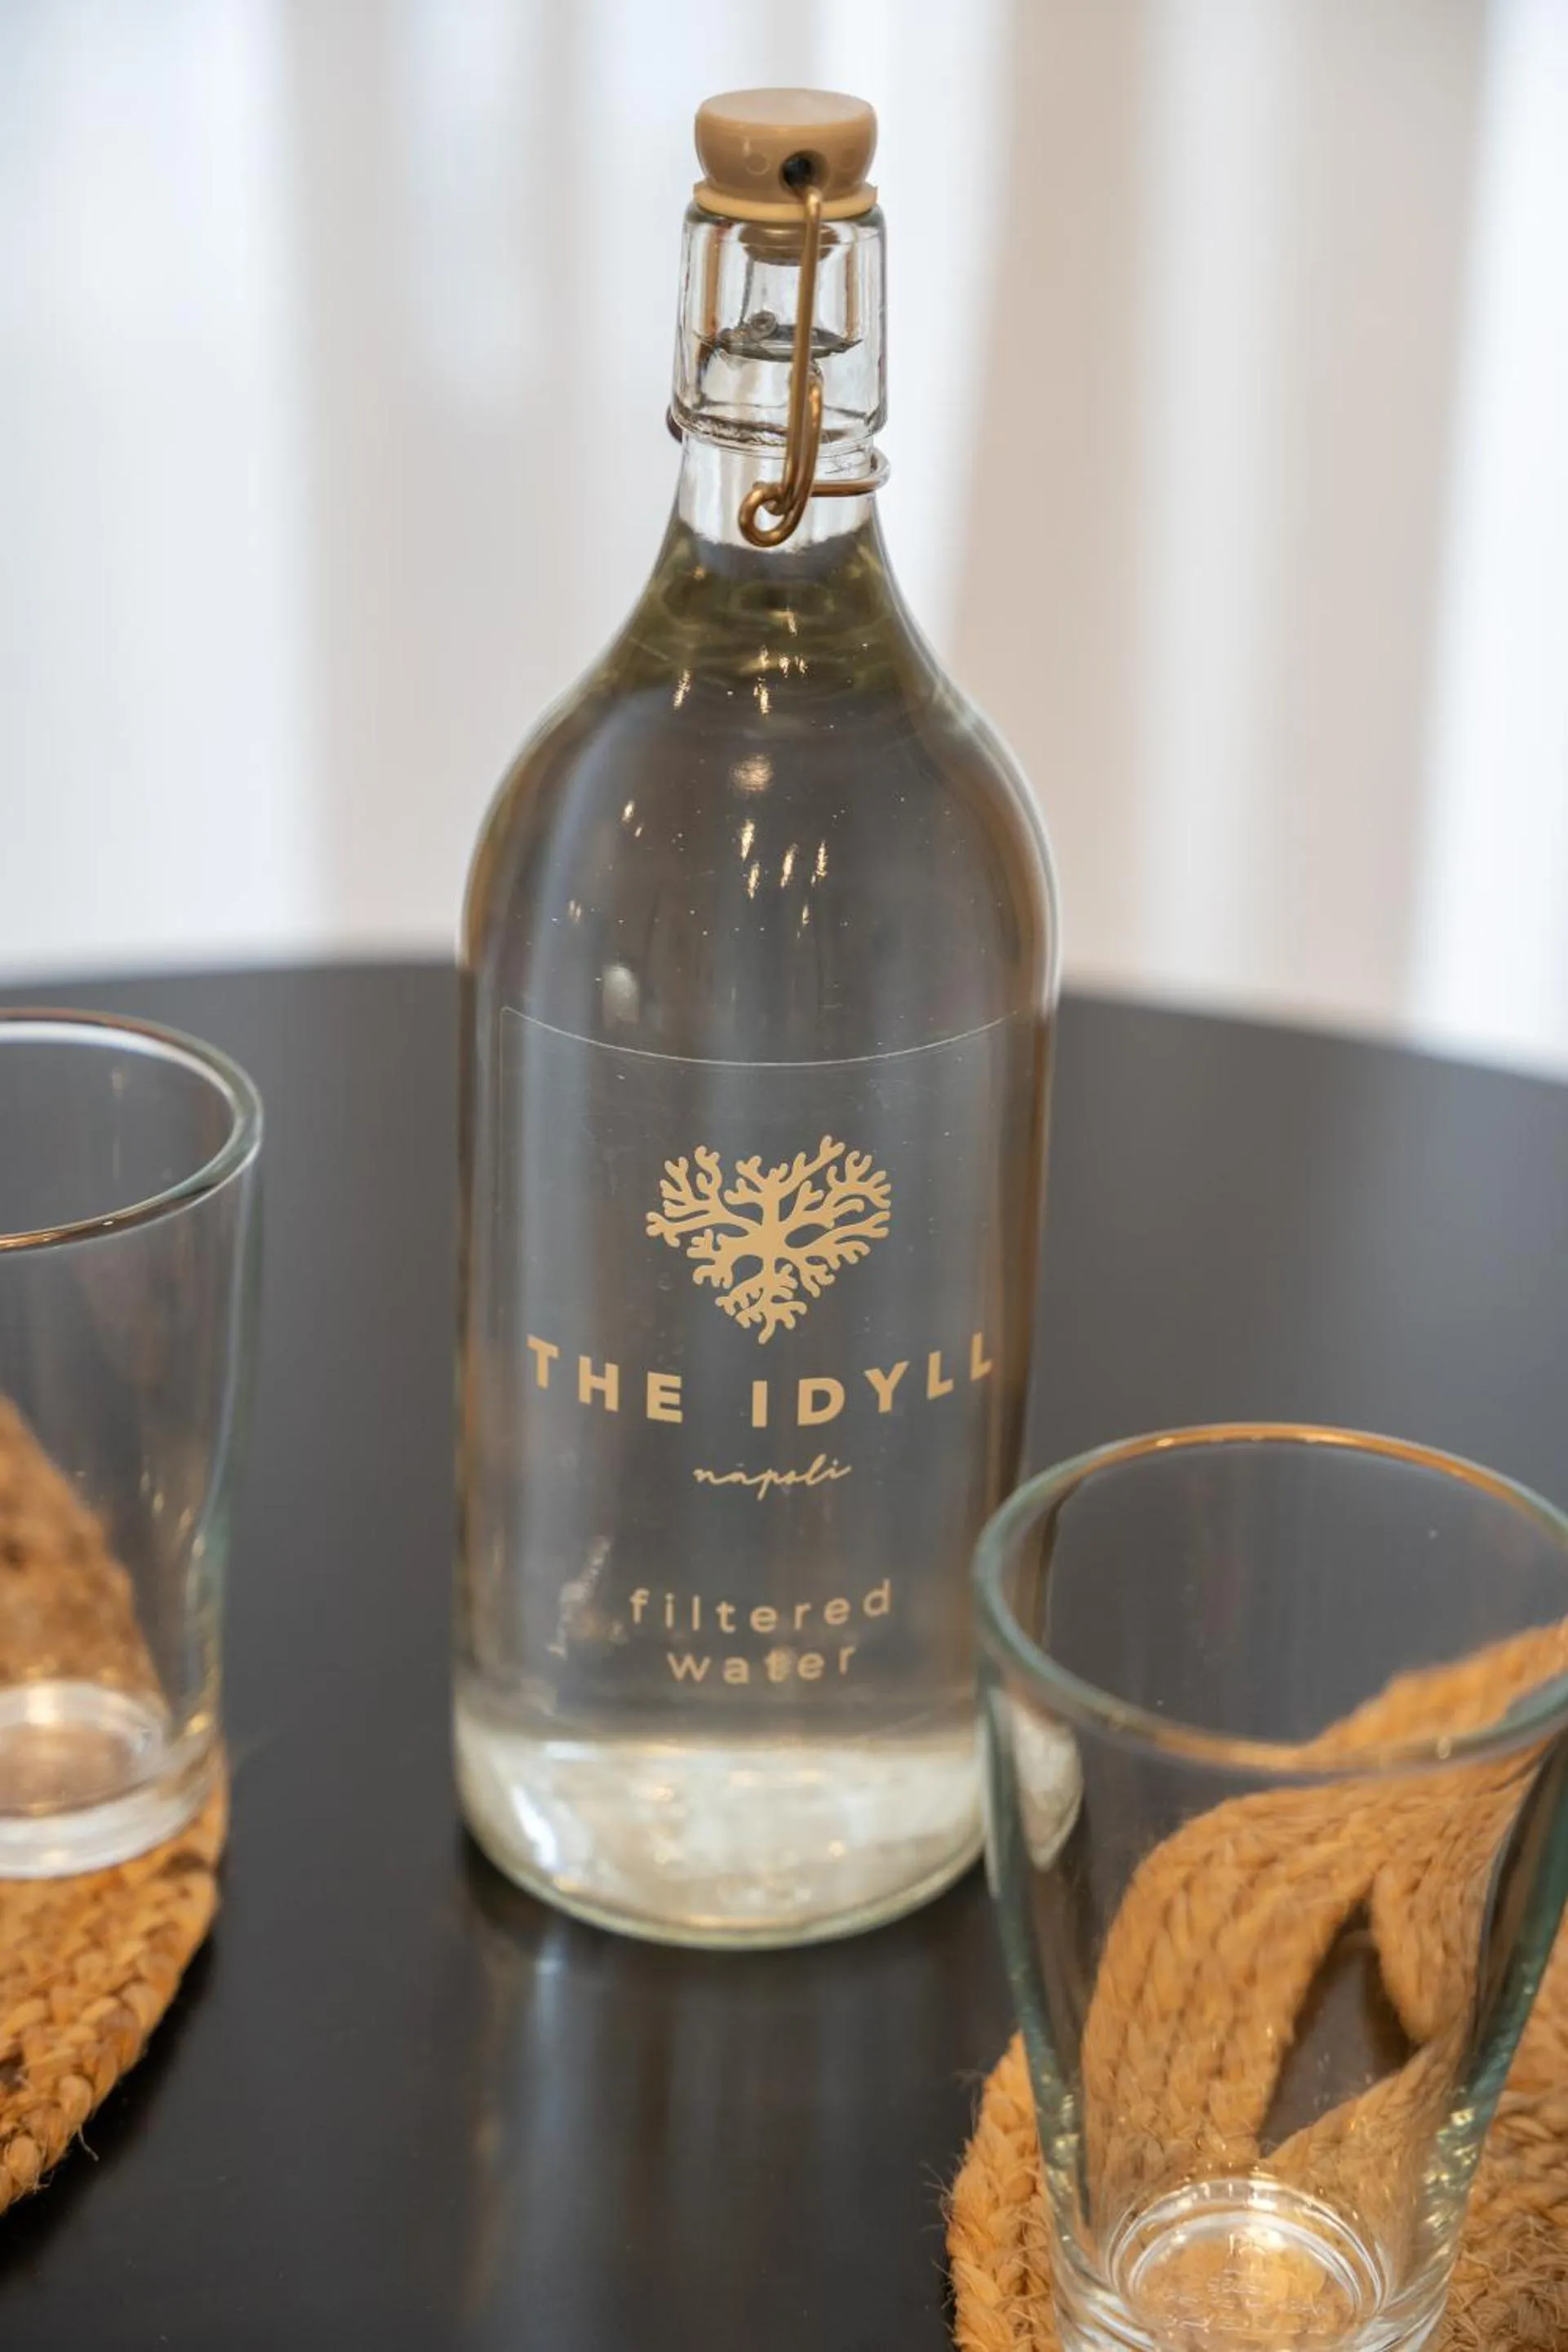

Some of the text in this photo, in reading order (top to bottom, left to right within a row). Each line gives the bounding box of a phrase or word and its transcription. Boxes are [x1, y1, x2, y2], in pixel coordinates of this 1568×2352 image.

[526, 1332, 993, 1427] THE IDYLL
[629, 1577, 891, 1634] filtered
[666, 1644, 856, 1684] water
